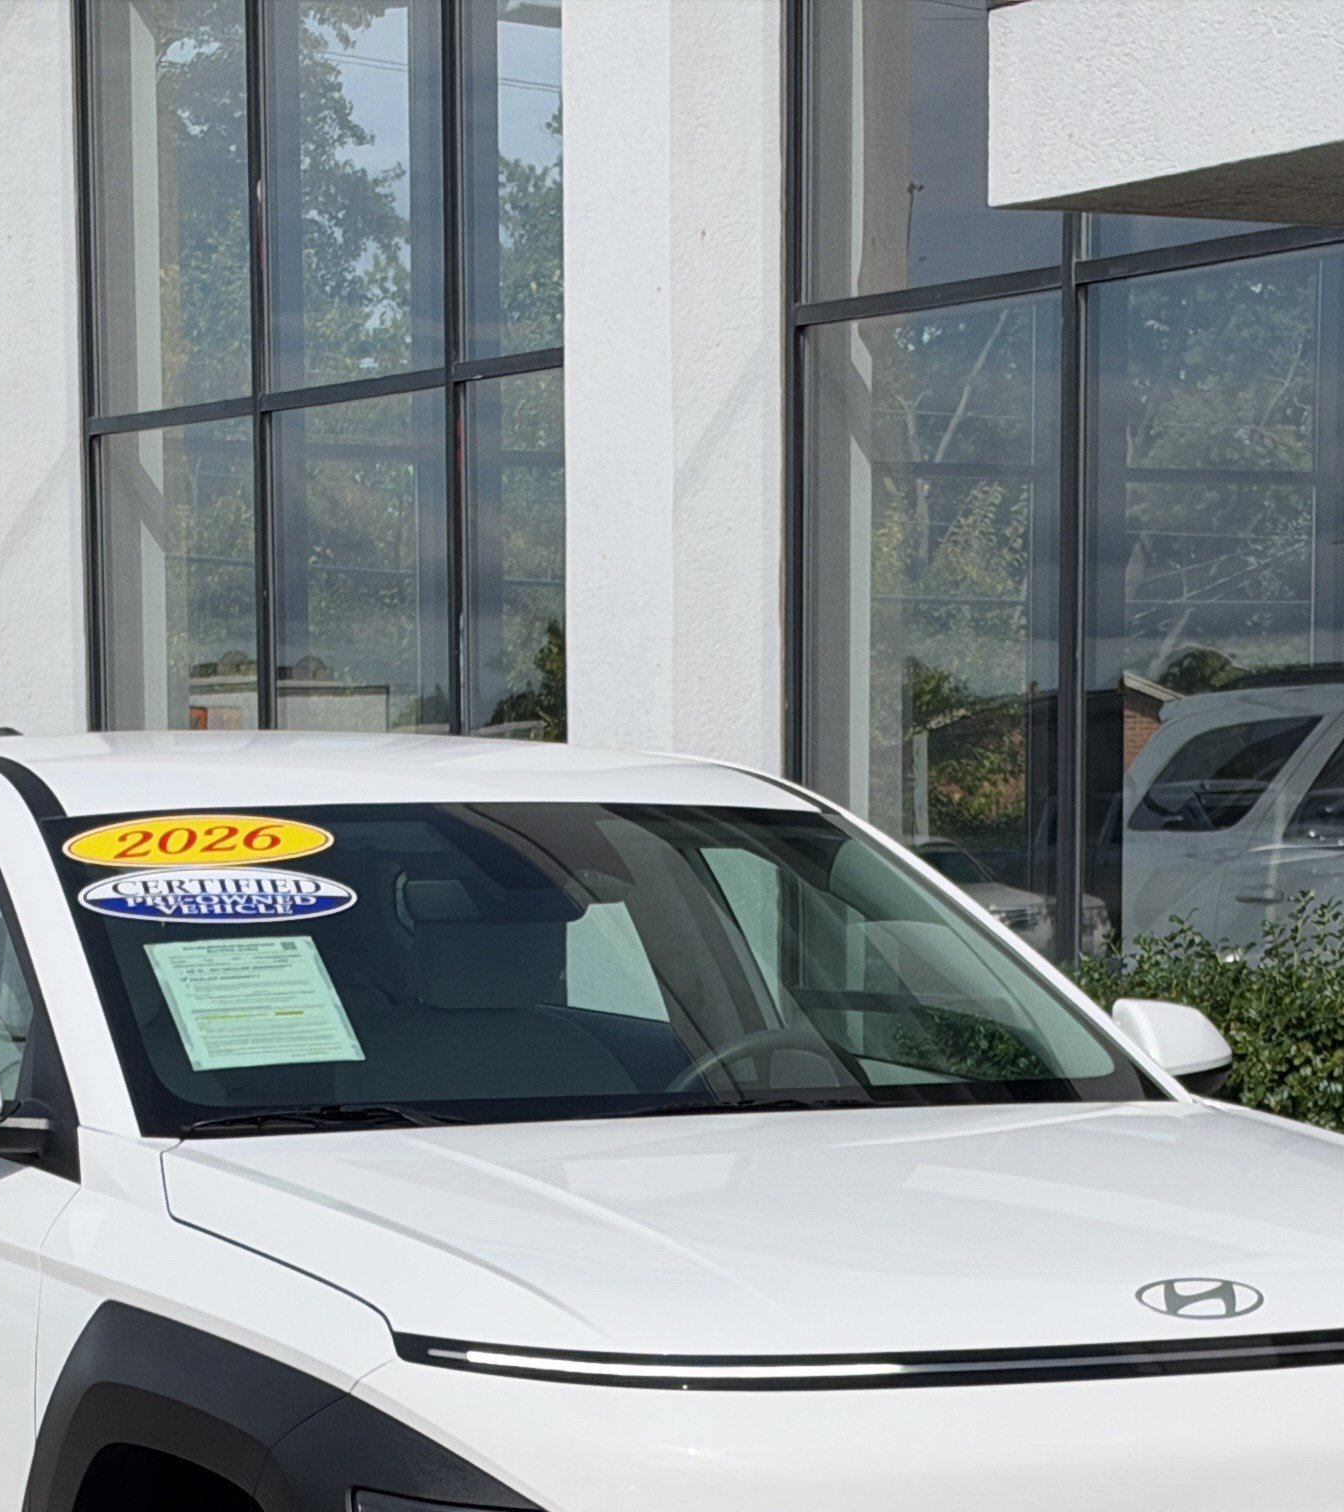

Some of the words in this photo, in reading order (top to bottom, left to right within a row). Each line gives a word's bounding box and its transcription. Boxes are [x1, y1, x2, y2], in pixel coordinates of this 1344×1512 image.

[113, 824, 285, 860] 2026
[112, 878, 322, 896] CERTIFIED
[125, 894, 318, 908] PRE-OWNED
[155, 902, 294, 915] VEHICLE
